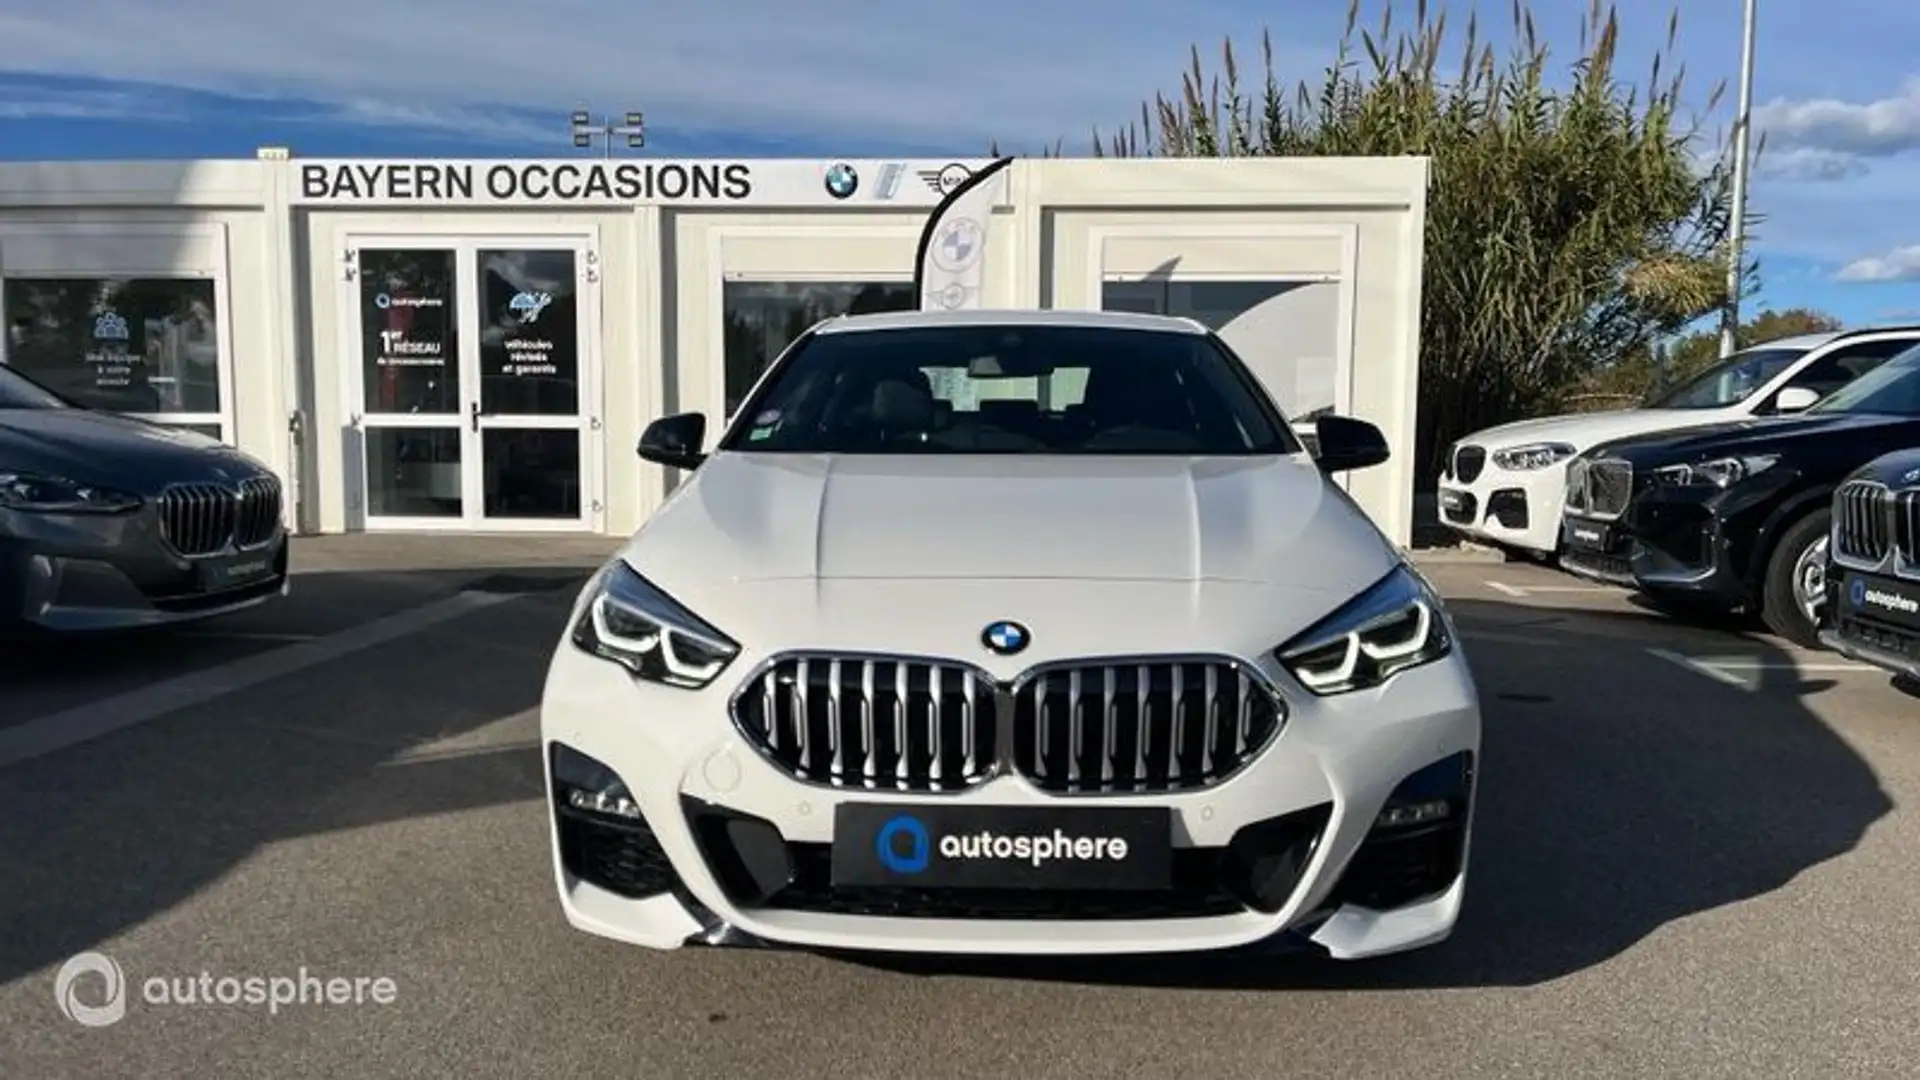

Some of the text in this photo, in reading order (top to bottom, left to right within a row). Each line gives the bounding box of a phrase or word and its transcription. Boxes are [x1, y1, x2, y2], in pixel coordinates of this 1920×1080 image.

[302, 164, 751, 199] BAYERN OCCASIONS
[939, 828, 1128, 867] autosphere
